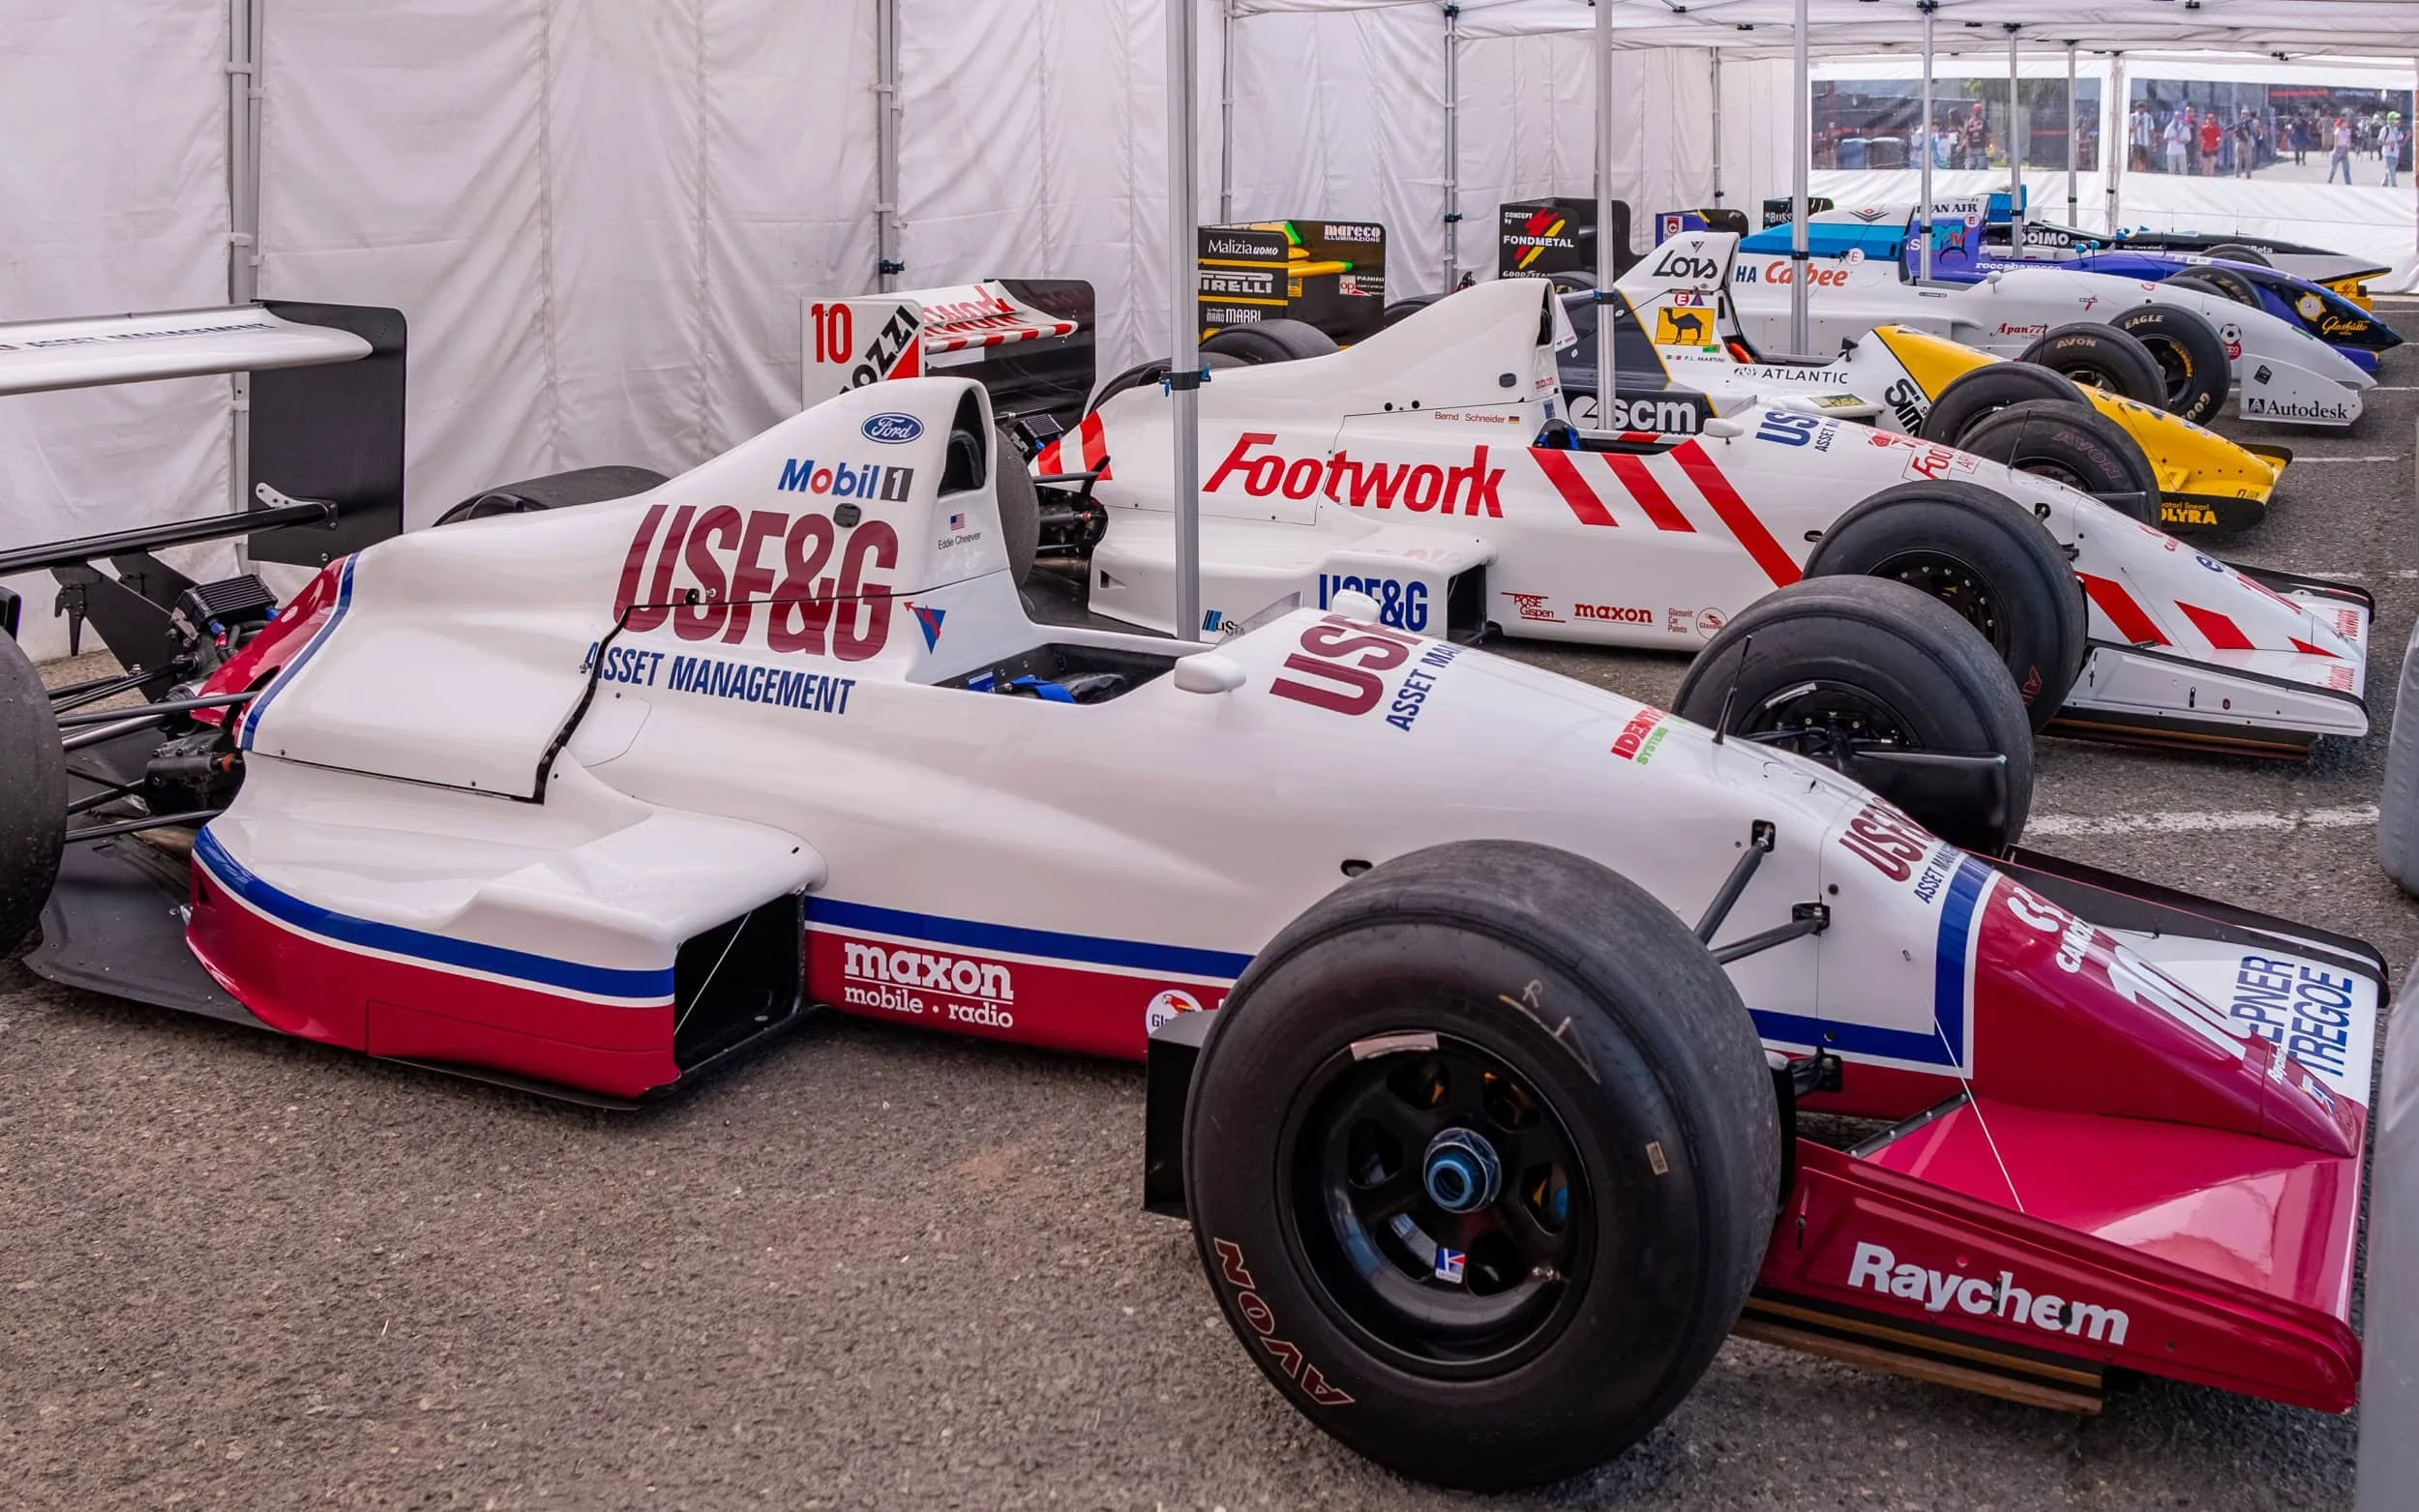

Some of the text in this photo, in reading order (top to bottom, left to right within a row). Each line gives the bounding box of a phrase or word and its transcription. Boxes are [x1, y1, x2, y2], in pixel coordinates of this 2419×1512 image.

[1208, 238, 1252, 254] Malizia
[1503, 235, 1575, 249] FONDMETAL
[1765, 260, 1848, 287] Cabee
[811, 303, 851, 364] 10
[2056, 339, 2098, 349] AVON
[1761, 368, 1849, 385] ATLANTIC
[870, 418, 914, 440] Ford
[1435, 411, 1506, 424] Bernd Schneider
[2266, 401, 2348, 420] Autodesk
[778, 459, 881, 500] Mobil
[1202, 431, 1507, 519] Footwork
[938, 531, 982, 550] Eddie Cheever
[612, 504, 899, 662] USF&G
[1520, 606, 1555, 619] Gispen
[1574, 602, 1653, 623] maxon
[586, 641, 855, 715] ASSET MANAGEMENT
[1386, 668, 1437, 732] ASSET
[1914, 866, 1945, 904] ASSET
[845, 942, 1014, 1000] maxon
[845, 985, 1014, 1029] mobile radio
[2287, 965, 2353, 1078] TREGOE
[1847, 1241, 2130, 1346] Raychem
[1213, 1237, 1356, 1407] AVON
